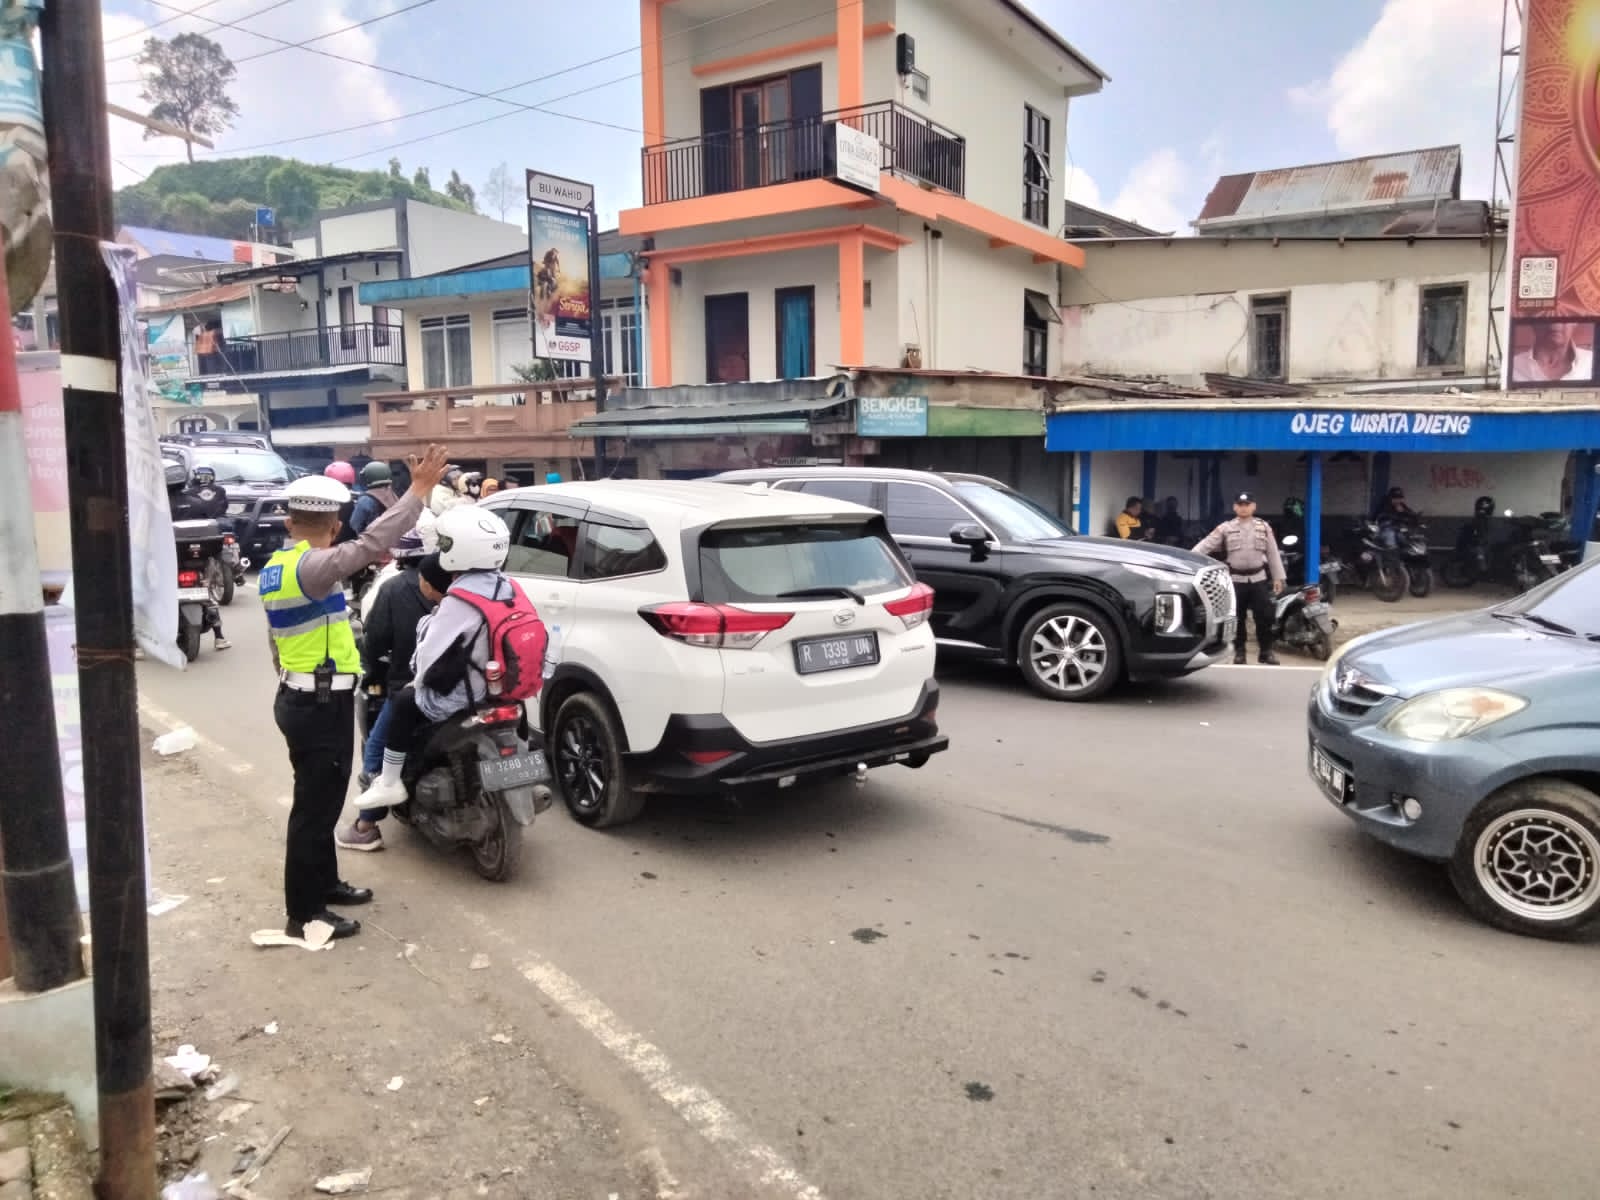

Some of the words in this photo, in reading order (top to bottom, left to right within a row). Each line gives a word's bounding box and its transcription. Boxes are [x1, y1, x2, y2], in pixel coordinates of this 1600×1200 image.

[539, 183, 551, 194] BU
[553, 185, 582, 201] WAHID
[860, 396, 925, 413] BENGKEL
[1290, 412, 1345, 435] OJEG
[1350, 411, 1409, 434] WISATA
[1412, 412, 1472, 435] DIENG
[802, 645, 813, 663] R
[821, 640, 849, 660] 1339
[855, 638, 871, 655] UN
